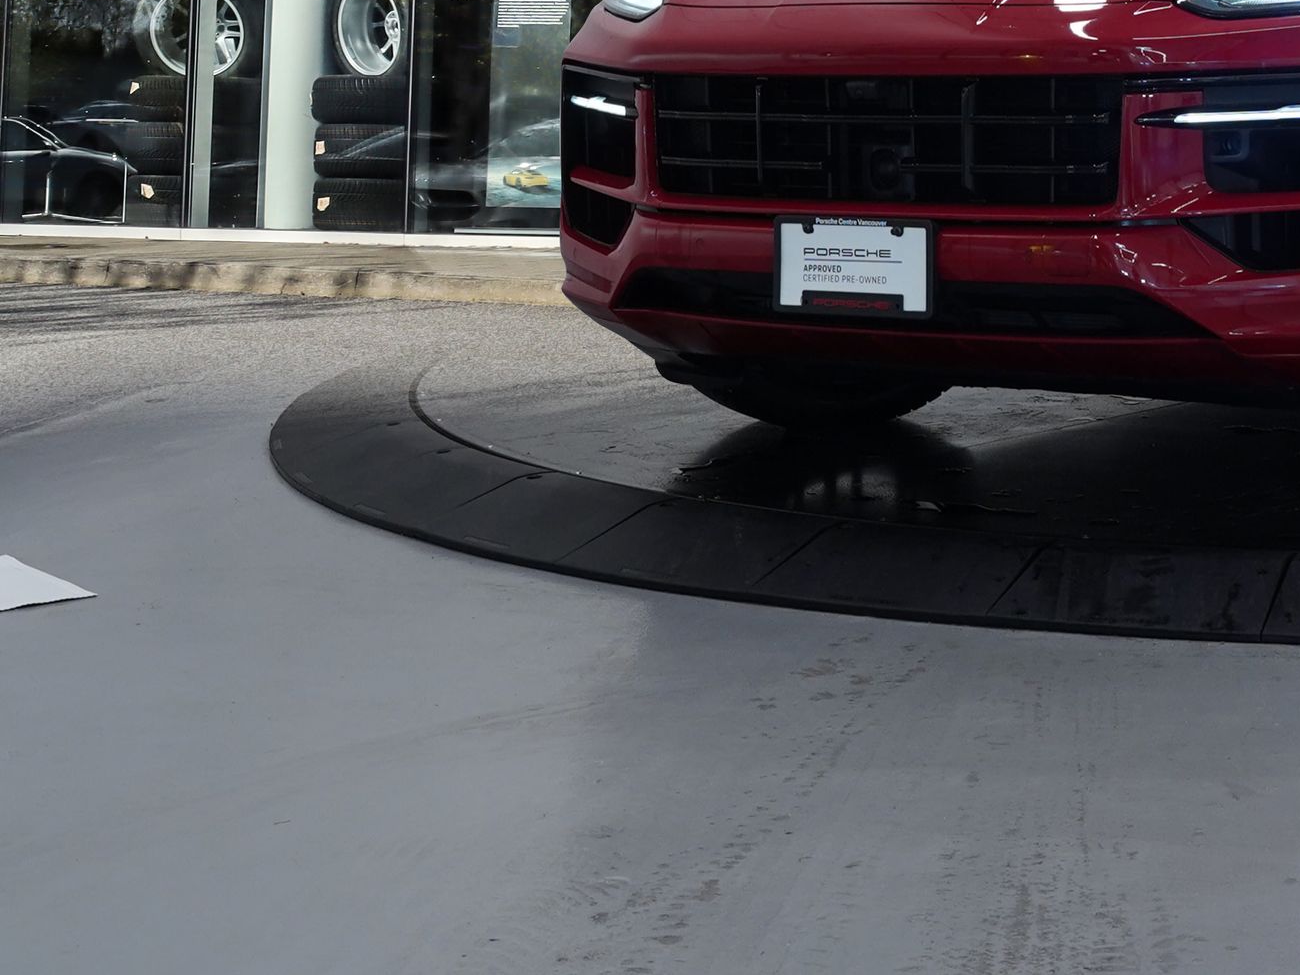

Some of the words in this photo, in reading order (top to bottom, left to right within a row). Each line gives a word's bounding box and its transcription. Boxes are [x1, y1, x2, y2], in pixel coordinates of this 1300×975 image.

[815, 217, 838, 225] Porsche
[838, 218, 858, 226] Centre
[858, 218, 887, 227] Vancouver
[803, 247, 892, 258] PORSCHE
[803, 264, 842, 273] APPROVED
[802, 274, 840, 283] CERTIFIED
[841, 275, 887, 285] PRE-OWNED
